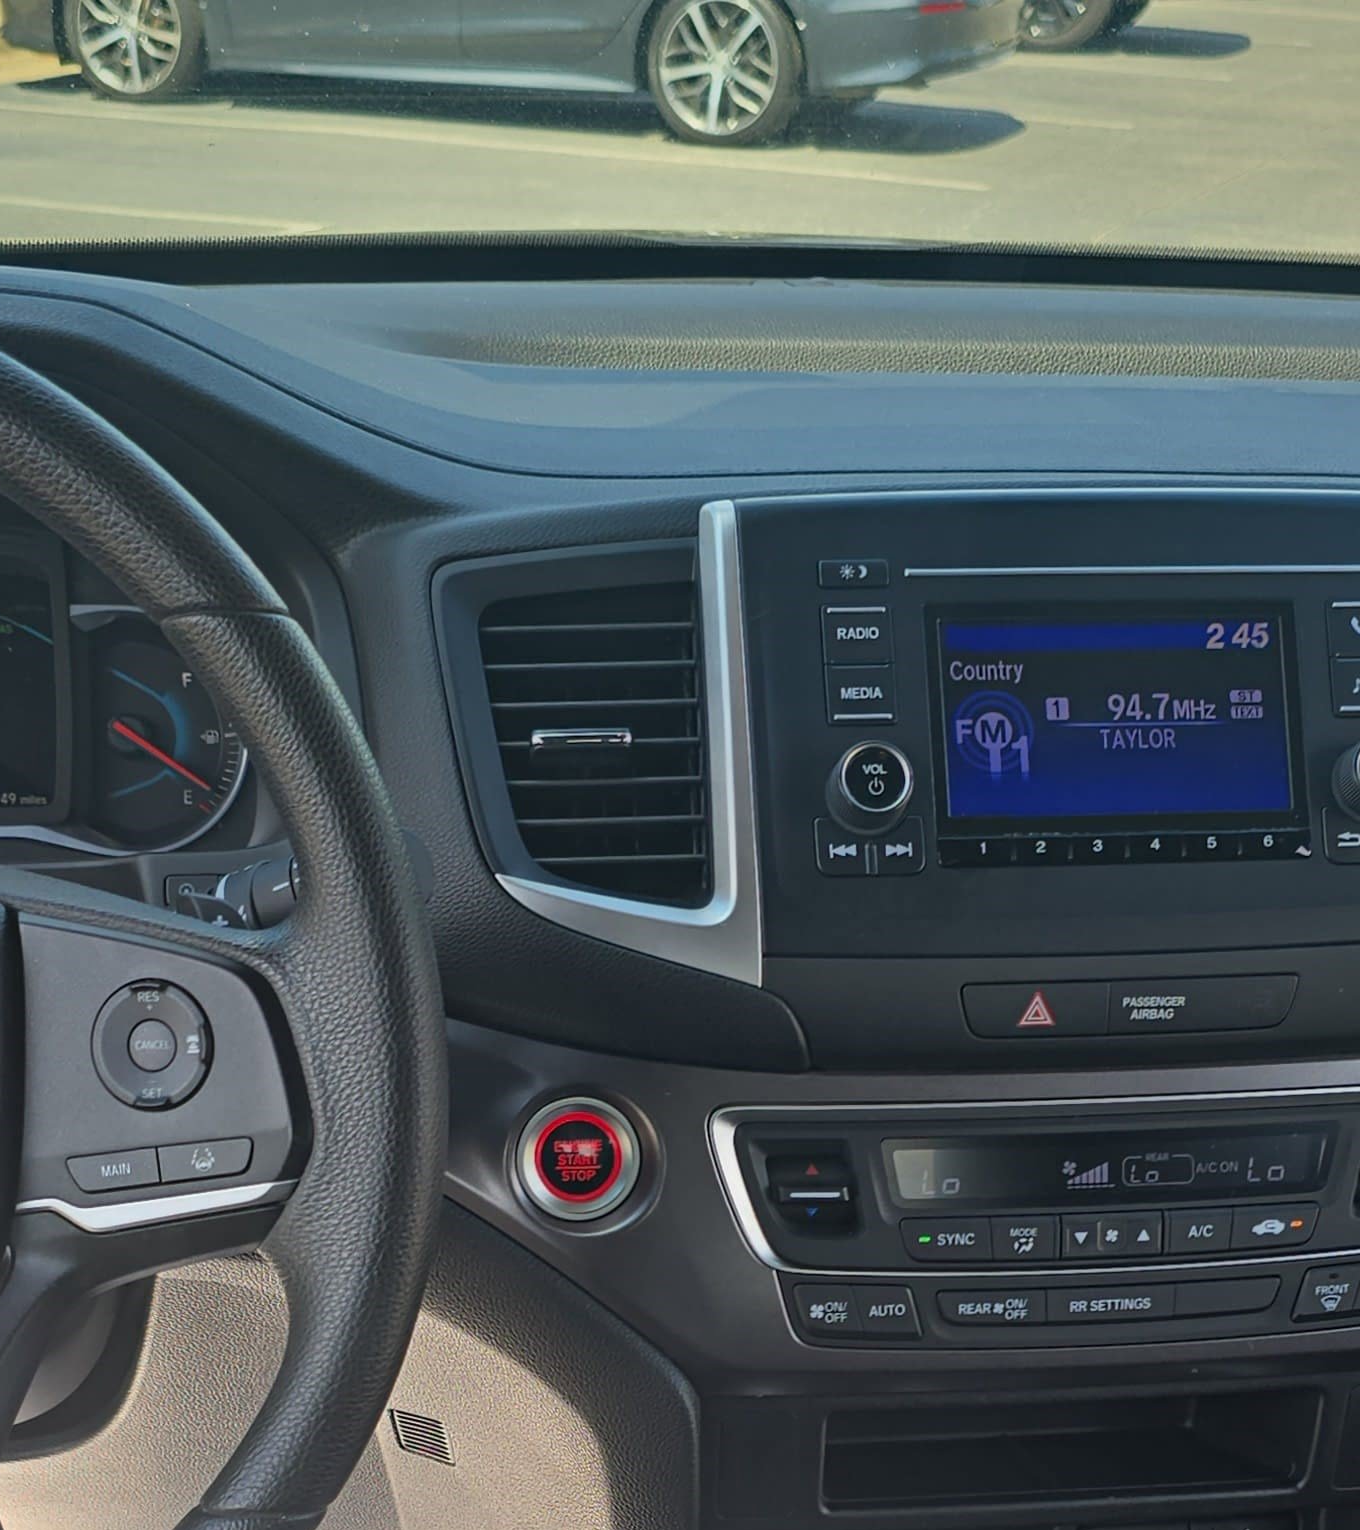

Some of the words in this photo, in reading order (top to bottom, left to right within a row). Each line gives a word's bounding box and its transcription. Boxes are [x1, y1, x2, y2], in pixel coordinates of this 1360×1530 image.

[836, 627, 880, 640] RADIO
[950, 660, 1024, 684] Country
[182, 672, 192, 688] F
[840, 686, 883, 700] MEDIA
[1099, 728, 1176, 749] TAYLOR
[862, 764, 888, 775] VOL
[183, 789, 192, 804] E
[980, 842, 987, 855] 1
[1035, 841, 1047, 854] 2
[1092, 839, 1104, 852] 3
[1150, 838, 1161, 850] 4
[1206, 836, 1218, 849] 5
[1263, 834, 1274, 847] 6
[137, 991, 160, 1003] RES
[1122, 996, 1186, 1008] PASSENGER
[1130, 1008, 1175, 1020] AIRBAG
[142, 1088, 161, 1099] SET
[557, 1153, 599, 1165] START
[101, 1163, 131, 1177] MAIN
[1196, 1163, 1217, 1174] A/C
[1220, 1161, 1239, 1173] ON
[561, 1169, 597, 1182] STOP
[1009, 1227, 1038, 1237] MODE
[1188, 1224, 1214, 1239] A/C
[937, 1232, 975, 1246] SYNC
[1315, 1283, 1349, 1295] FRONT
[868, 1303, 906, 1317] AUTO
[958, 1303, 991, 1315] REAR
[1069, 1301, 1088, 1313] RR
[1090, 1297, 1152, 1312] SETTINGS
[824, 1312, 848, 1324] OFF
[1005, 1309, 1028, 1320] OFF
